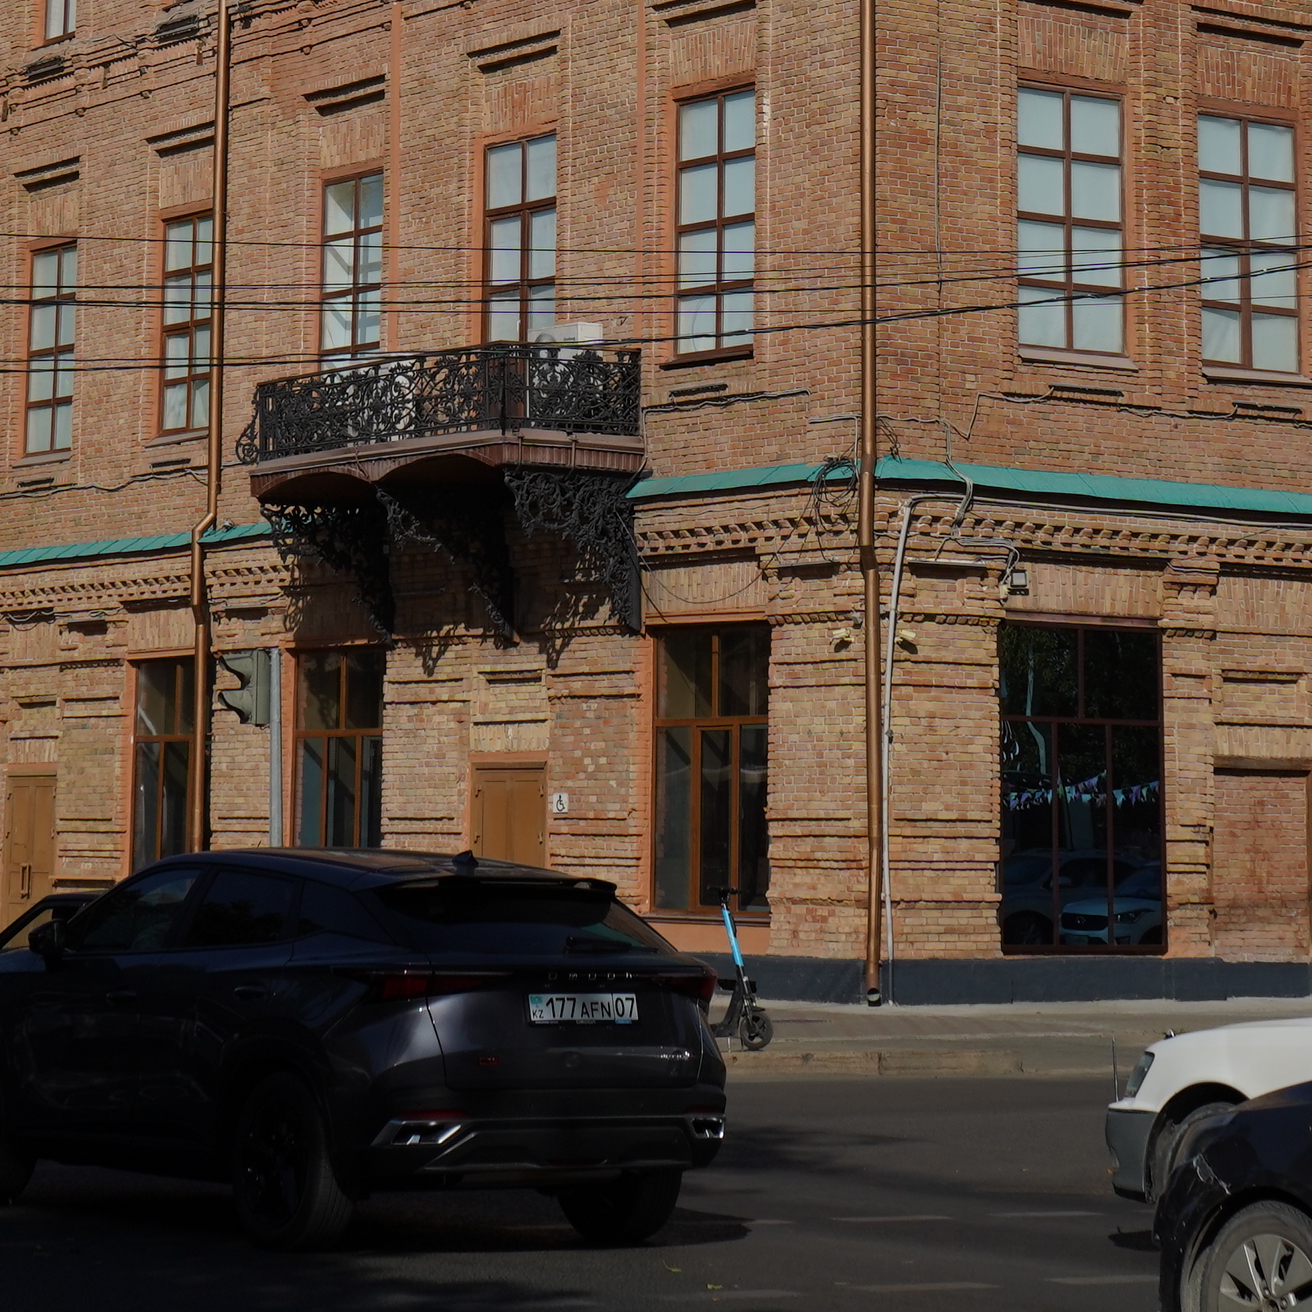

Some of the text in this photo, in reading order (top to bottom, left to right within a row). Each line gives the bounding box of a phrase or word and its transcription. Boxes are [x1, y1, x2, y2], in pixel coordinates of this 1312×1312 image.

[532, 997, 635, 1019] KZ 177AFN 07
